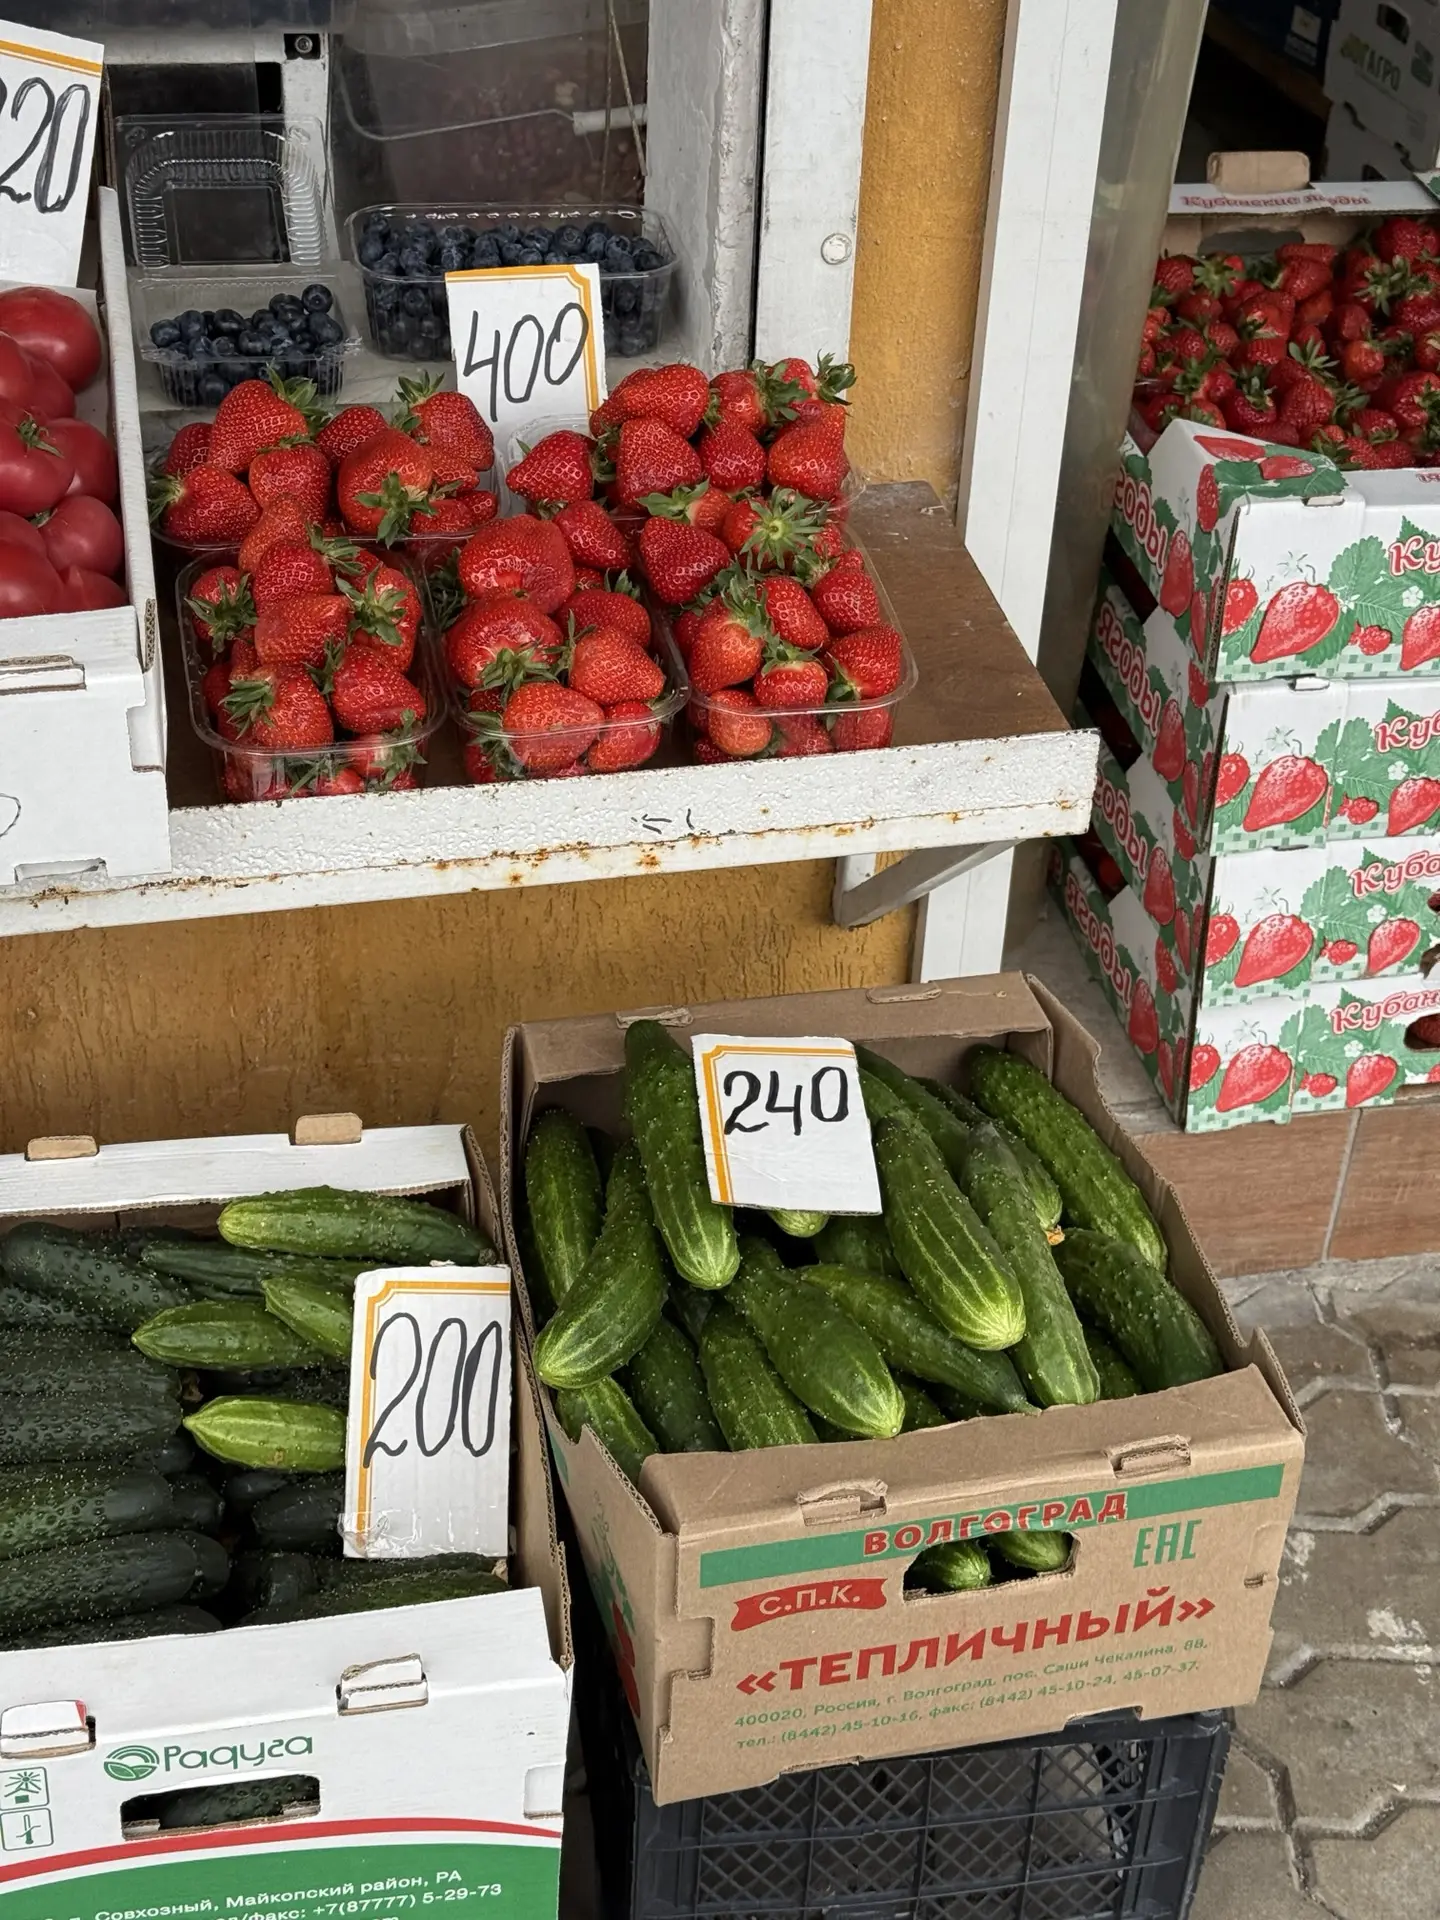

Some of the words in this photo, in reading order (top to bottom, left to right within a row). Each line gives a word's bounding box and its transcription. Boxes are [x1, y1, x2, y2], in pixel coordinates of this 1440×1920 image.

[0, 77, 90, 213] 20
[463, 302, 589, 422] 400
[1097, 601, 1162, 738] Ягоды
[1064, 872, 1132, 1009] Ягоды
[723, 1066, 849, 1136] 240
[364, 1312, 503, 1468] 200
[863, 1491, 1128, 1557] ВОЛГОГРАД
[758, 1584, 862, 1616] С.П.К.
[736, 1585, 1216, 1696] «ТЕПЛИЧНЫЙ»
[734, 1707, 807, 1727] 400020,
[814, 1698, 881, 1716] Россия,
[886, 1695, 898, 1705] г.
[903, 1677, 997, 1702] Волгоград,
[1002, 1669, 1038, 1683] пос.
[1043, 1658, 1090, 1675] Саши
[780, 1724, 837, 1743] (8442)
[979, 1689, 1033, 1709] (8442)
[163, 1735, 314, 1773] Радуга
[94, 1899, 219, 1920] Совхозный,
[226, 1883, 354, 1908] Майкопский
[360, 1875, 429, 1895] район,
[435, 1869, 462, 1884] РА
[421, 1883, 502, 1904] 5-29-73
